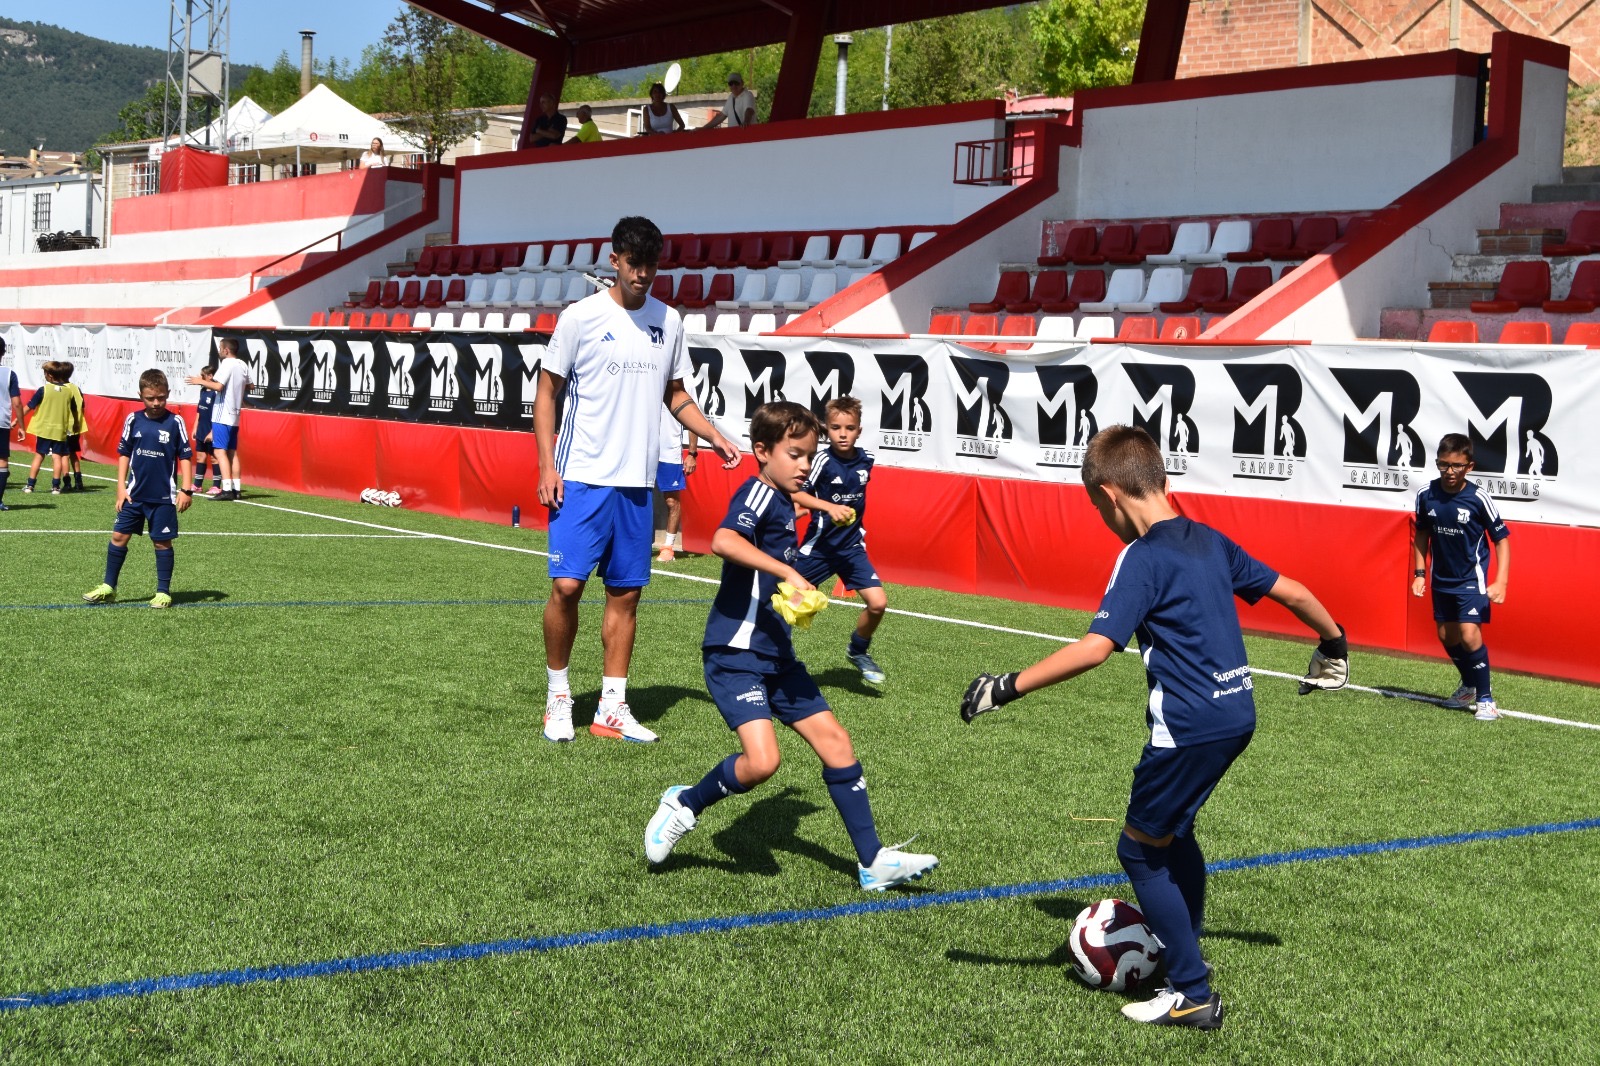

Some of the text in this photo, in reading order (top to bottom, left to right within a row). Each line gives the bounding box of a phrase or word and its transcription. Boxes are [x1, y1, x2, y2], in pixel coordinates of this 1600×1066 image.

[106, 348, 134, 361] ROCNATION
[156, 349, 186, 364] ROCNATION
[166, 366, 186, 378] SPORTS
[351, 394, 370, 403] CAMPUS
[390, 397, 410, 406] CAMPUS
[431, 400, 454, 409] CAMPUS
[476, 402, 498, 412] CAMPUS
[884, 435, 923, 448] CAMPUS
[961, 440, 1000, 456] CAMPUS
[1240, 460, 1294, 476] CAMPUS
[1350, 470, 1410, 487] CAMPUS
